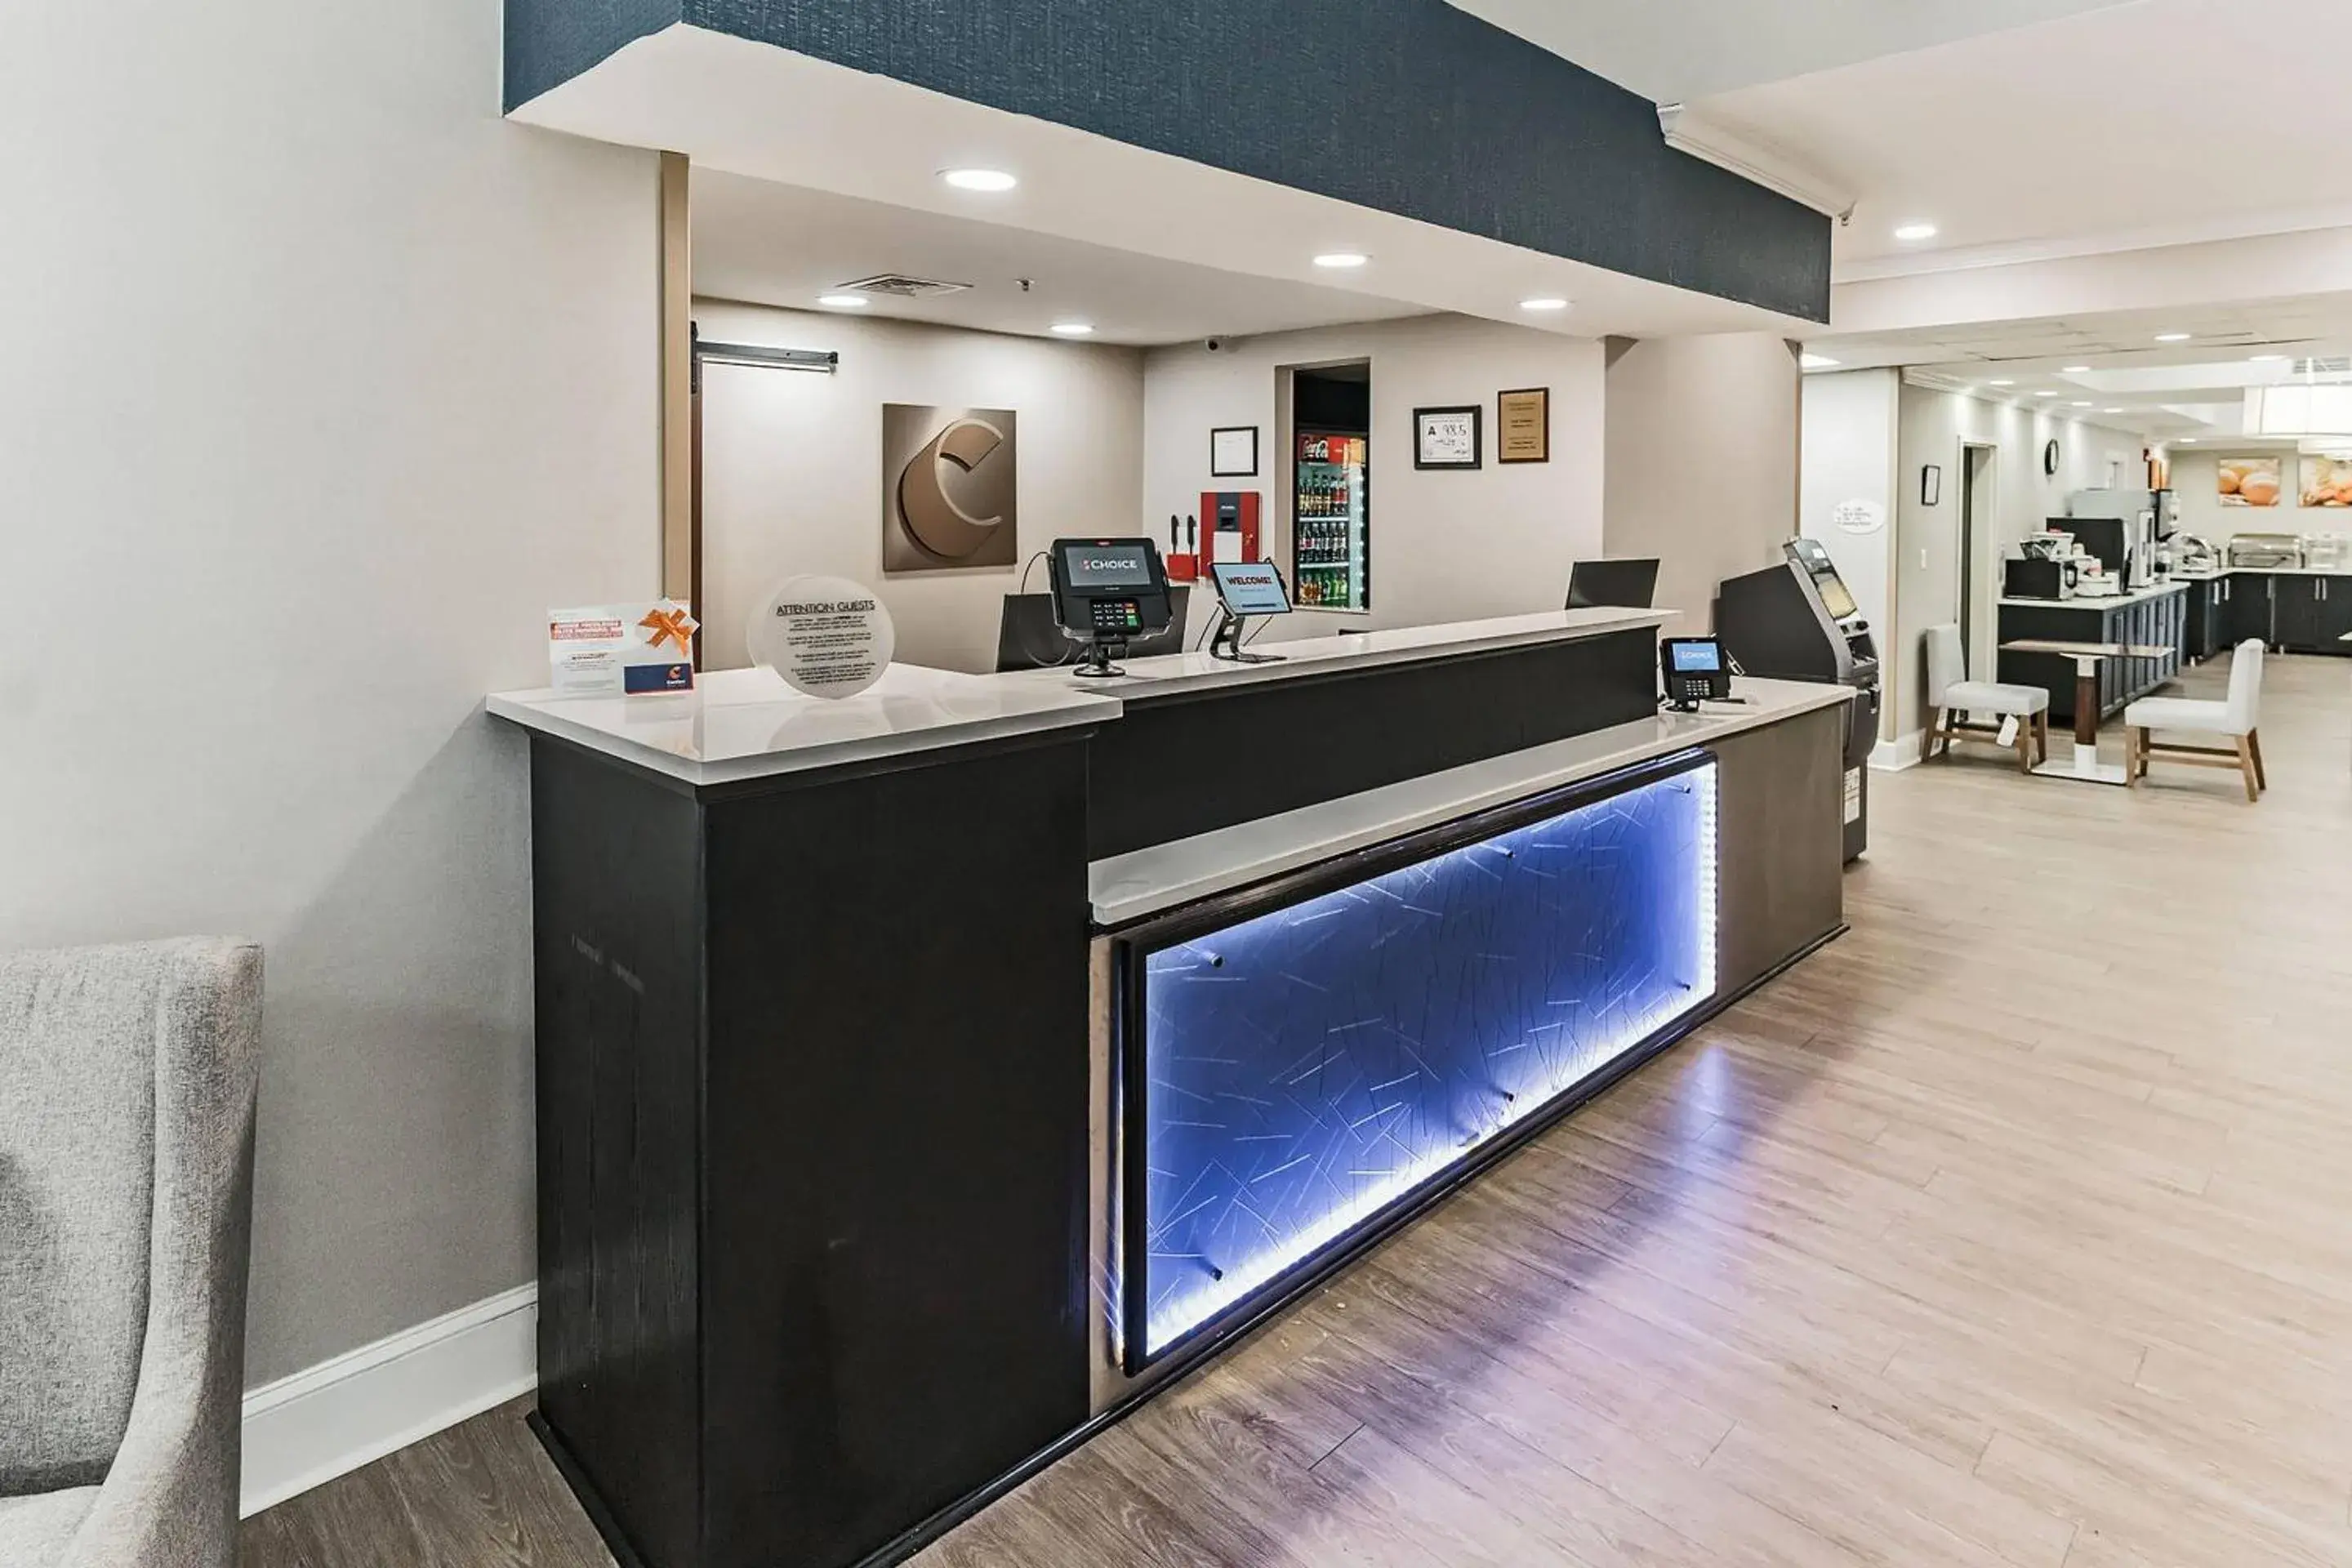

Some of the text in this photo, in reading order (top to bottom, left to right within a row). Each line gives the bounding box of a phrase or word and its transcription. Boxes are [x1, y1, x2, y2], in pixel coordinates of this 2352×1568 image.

[1091, 559, 1137, 570] CHOICE
[777, 600, 875, 616] ATTENTION GUESTS
